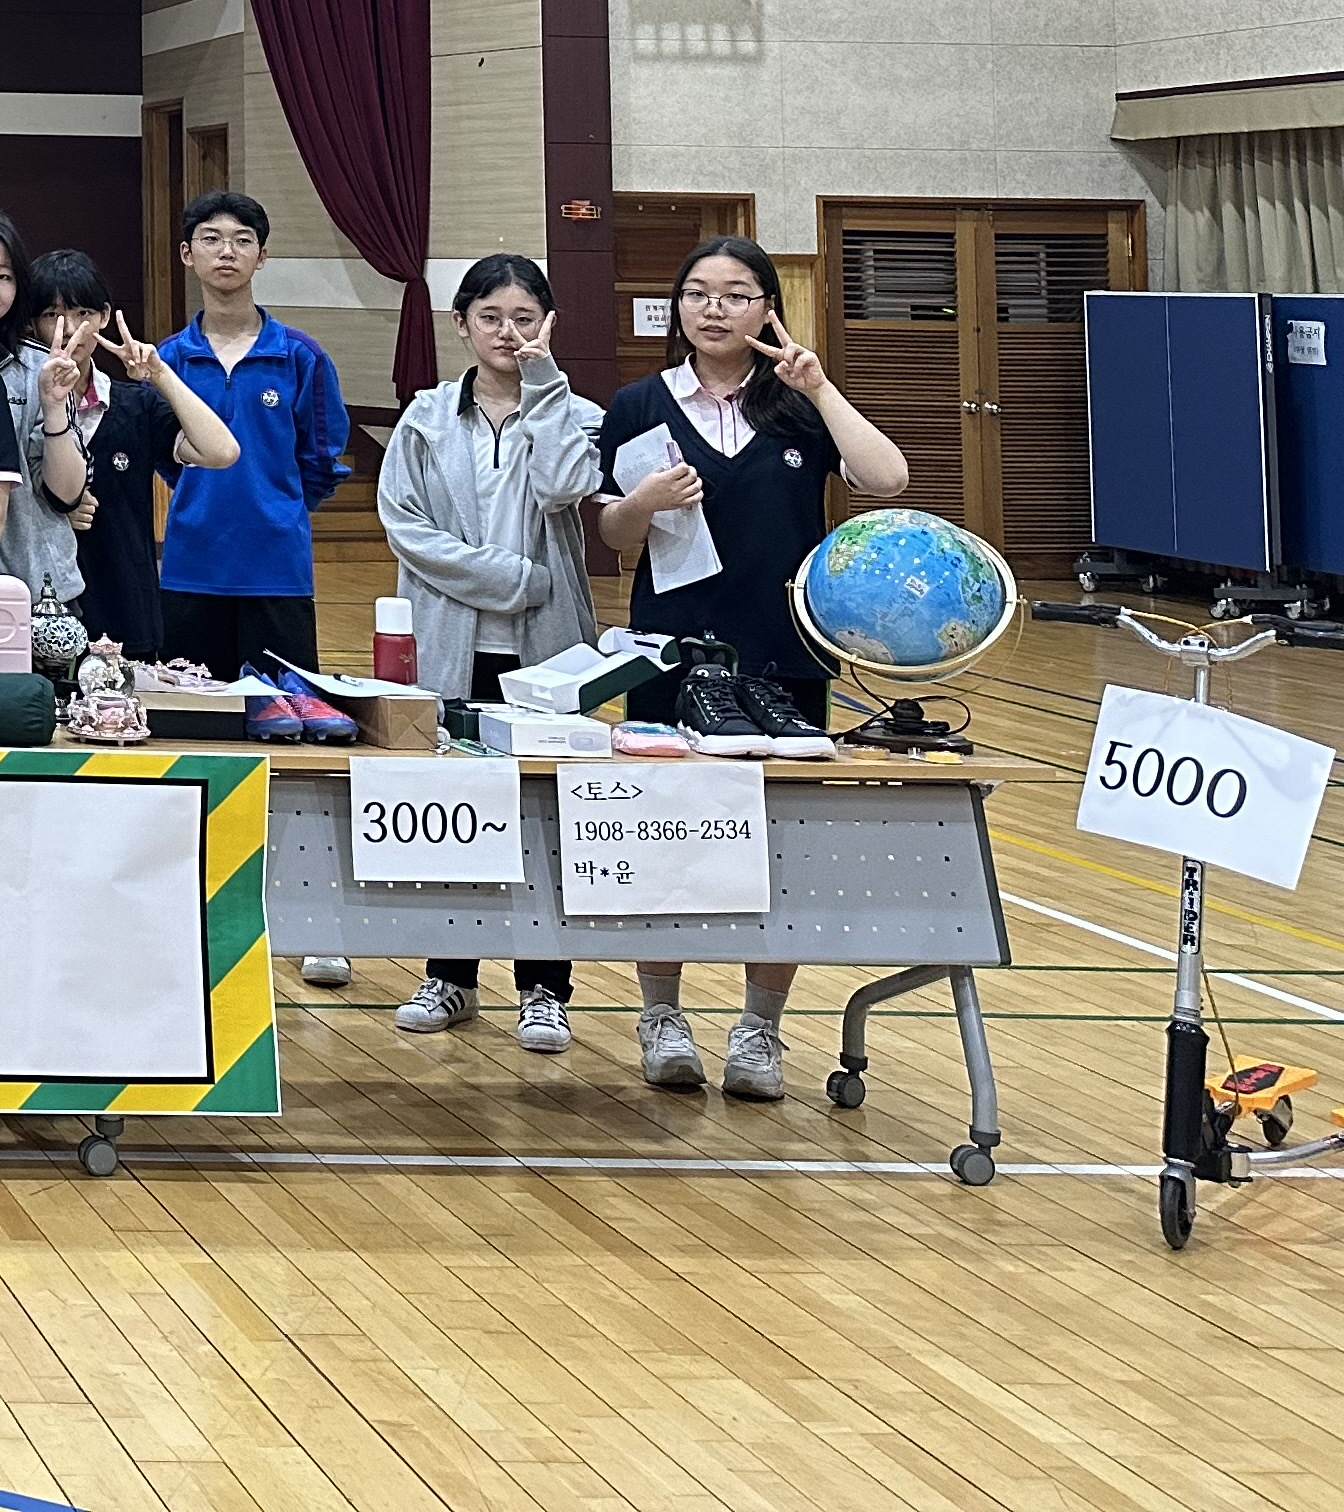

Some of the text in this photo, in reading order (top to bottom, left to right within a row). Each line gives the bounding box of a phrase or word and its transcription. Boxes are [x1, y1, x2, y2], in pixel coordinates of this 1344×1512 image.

[570, 781, 644, 801] <토스>
[1098, 740, 1247, 819] 5000
[362, 801, 507, 844] 3000~
[574, 819, 752, 842] 1908-8366-2534
